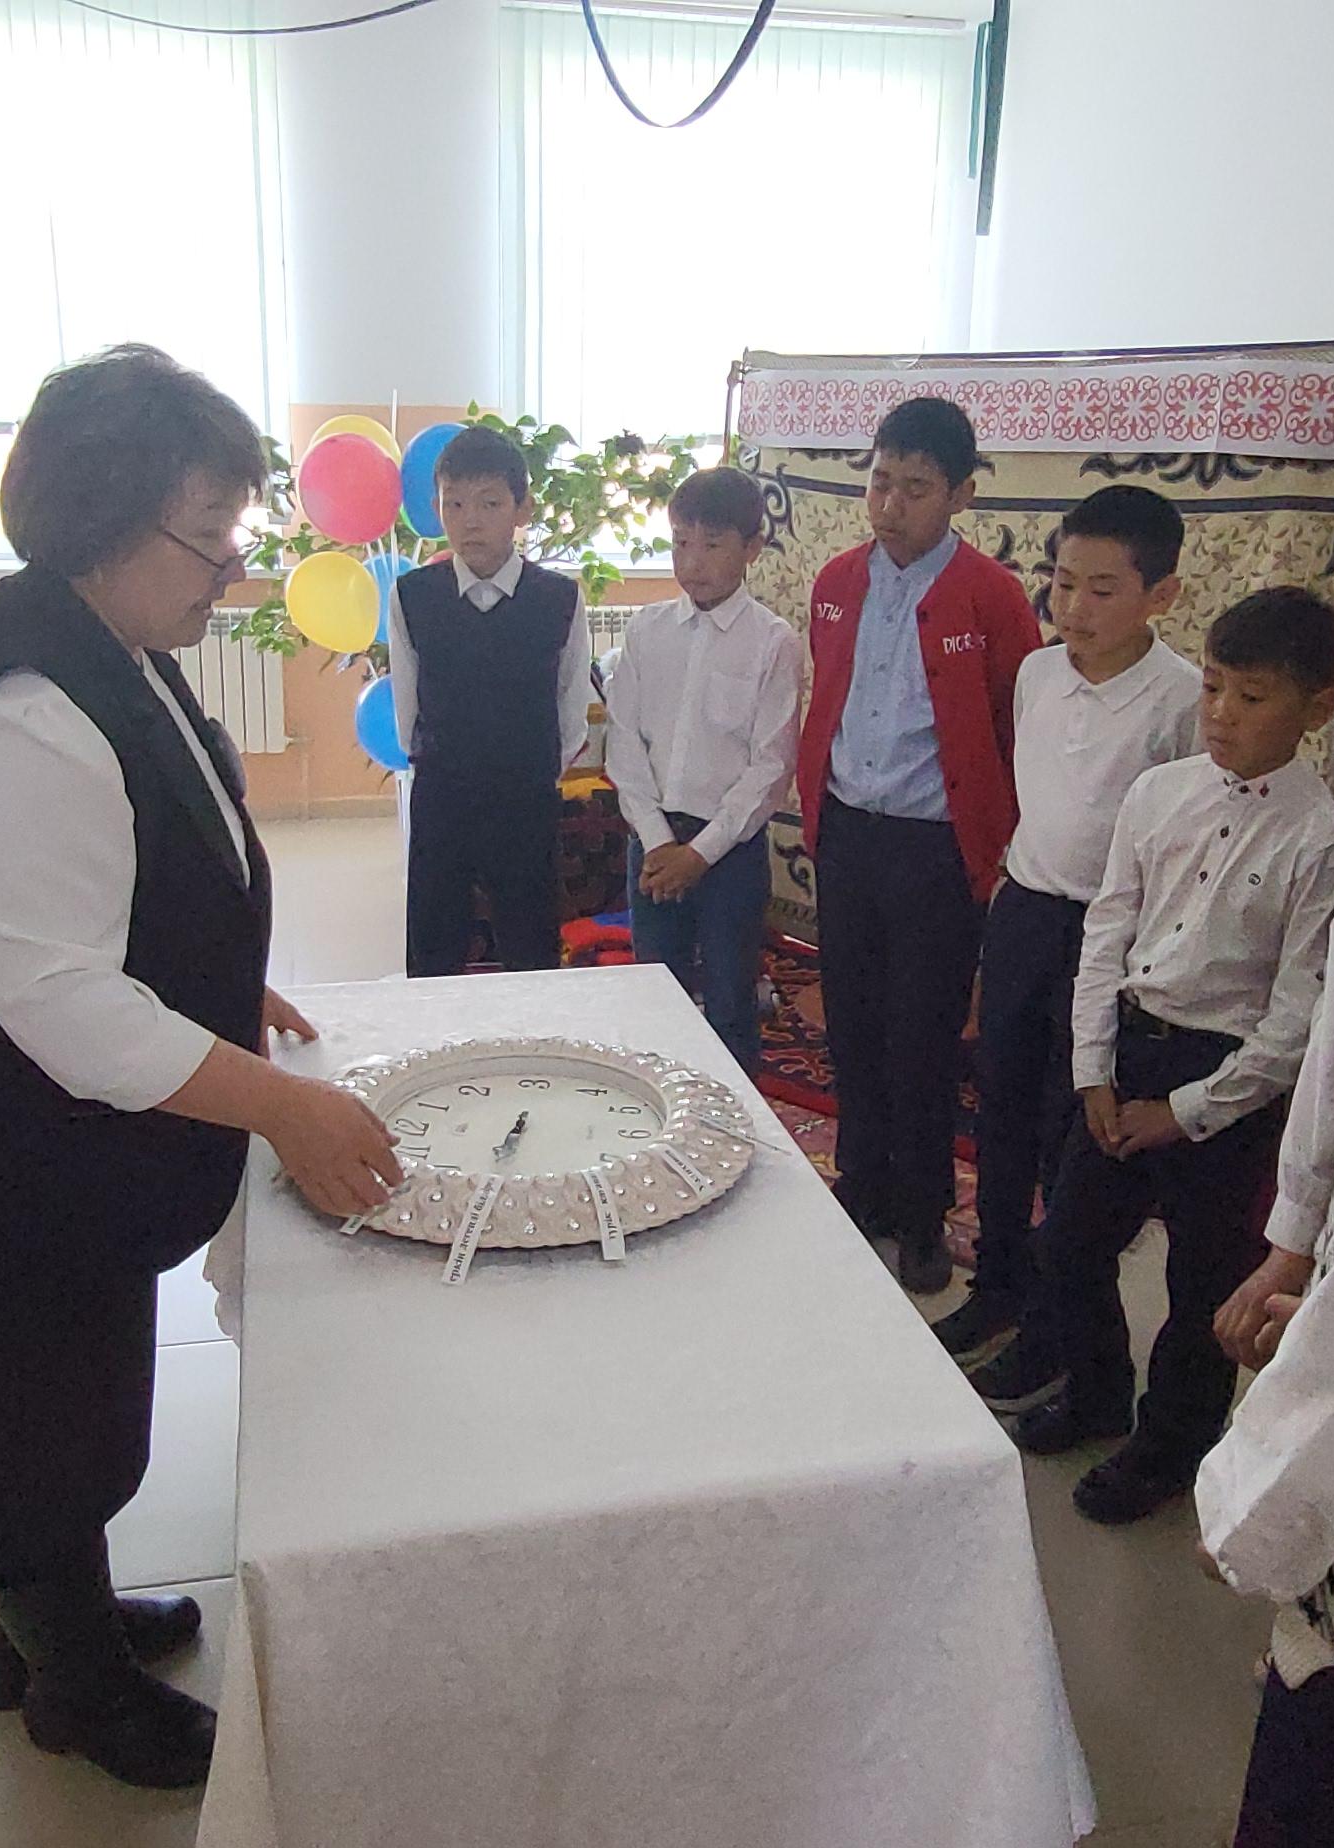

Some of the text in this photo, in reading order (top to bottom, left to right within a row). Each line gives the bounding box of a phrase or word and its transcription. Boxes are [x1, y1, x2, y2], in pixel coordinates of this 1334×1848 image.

[518, 1079, 551, 1090] 3
[458, 1085, 491, 1097] 2
[575, 1088, 608, 1097] 4
[417, 1101, 450, 1112] 1
[394, 1118, 429, 1137] 12
[618, 1129, 652, 1139] 6
